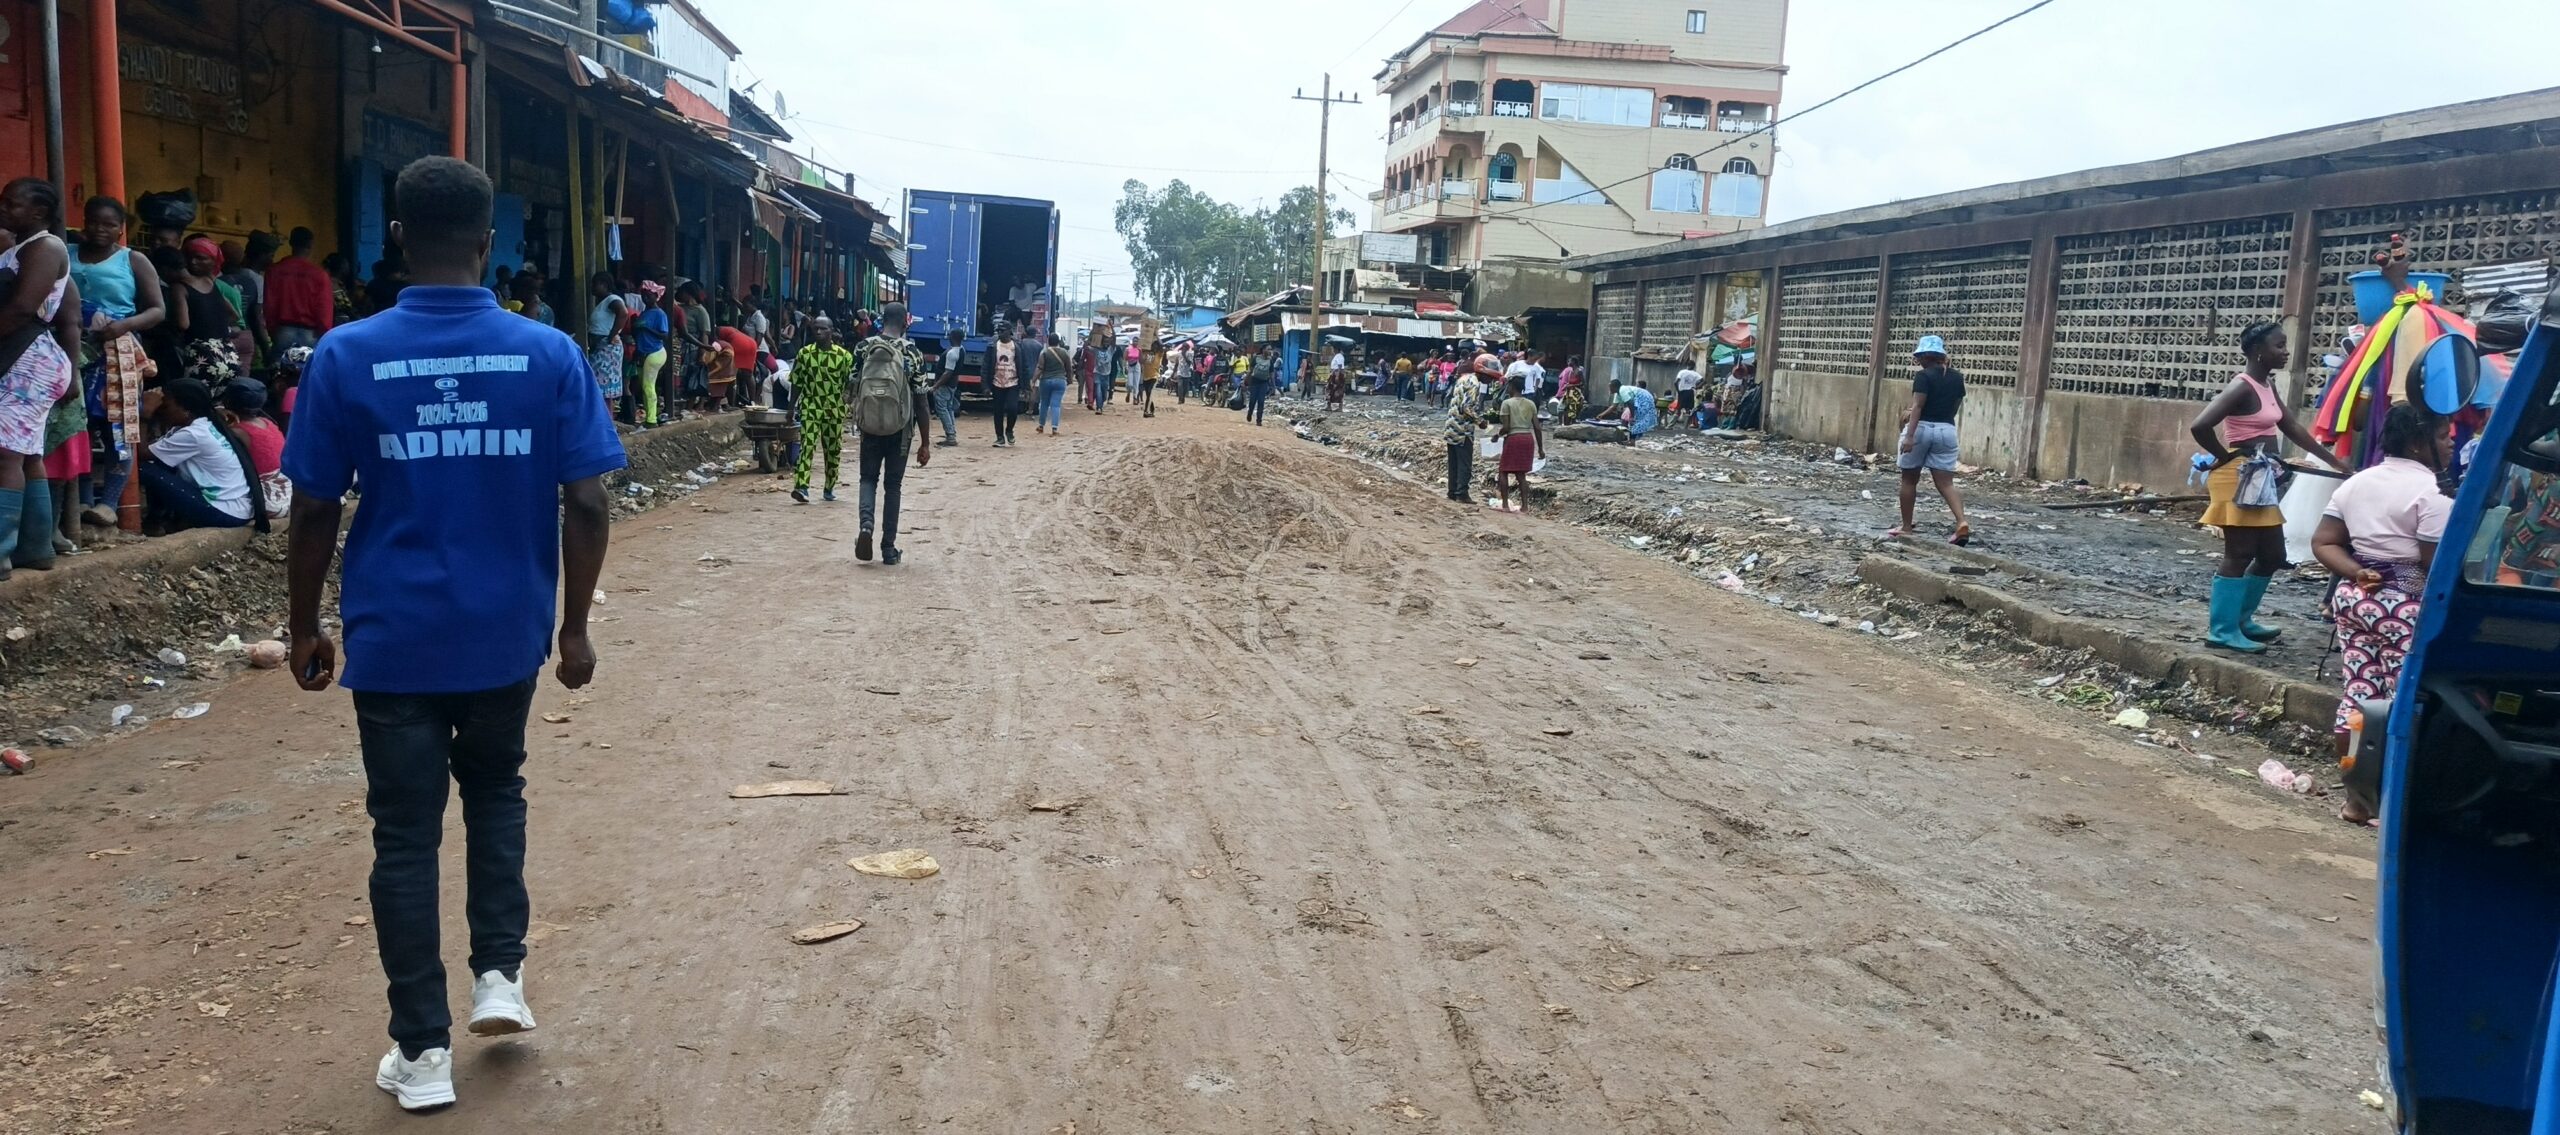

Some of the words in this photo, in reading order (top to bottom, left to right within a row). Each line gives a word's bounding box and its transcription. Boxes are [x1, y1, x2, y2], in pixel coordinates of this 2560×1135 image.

[174, 51, 239, 97] TRADING
[143, 86, 195, 119] CENTER
[372, 360, 410, 381] ROYAL
[408, 356, 475, 377] TREASURES
[475, 354, 530, 372] ACADEMY
[443, 391, 459, 402] 2
[416, 401, 488, 426] 2024-2026
[378, 428, 532, 461] ADMIN
